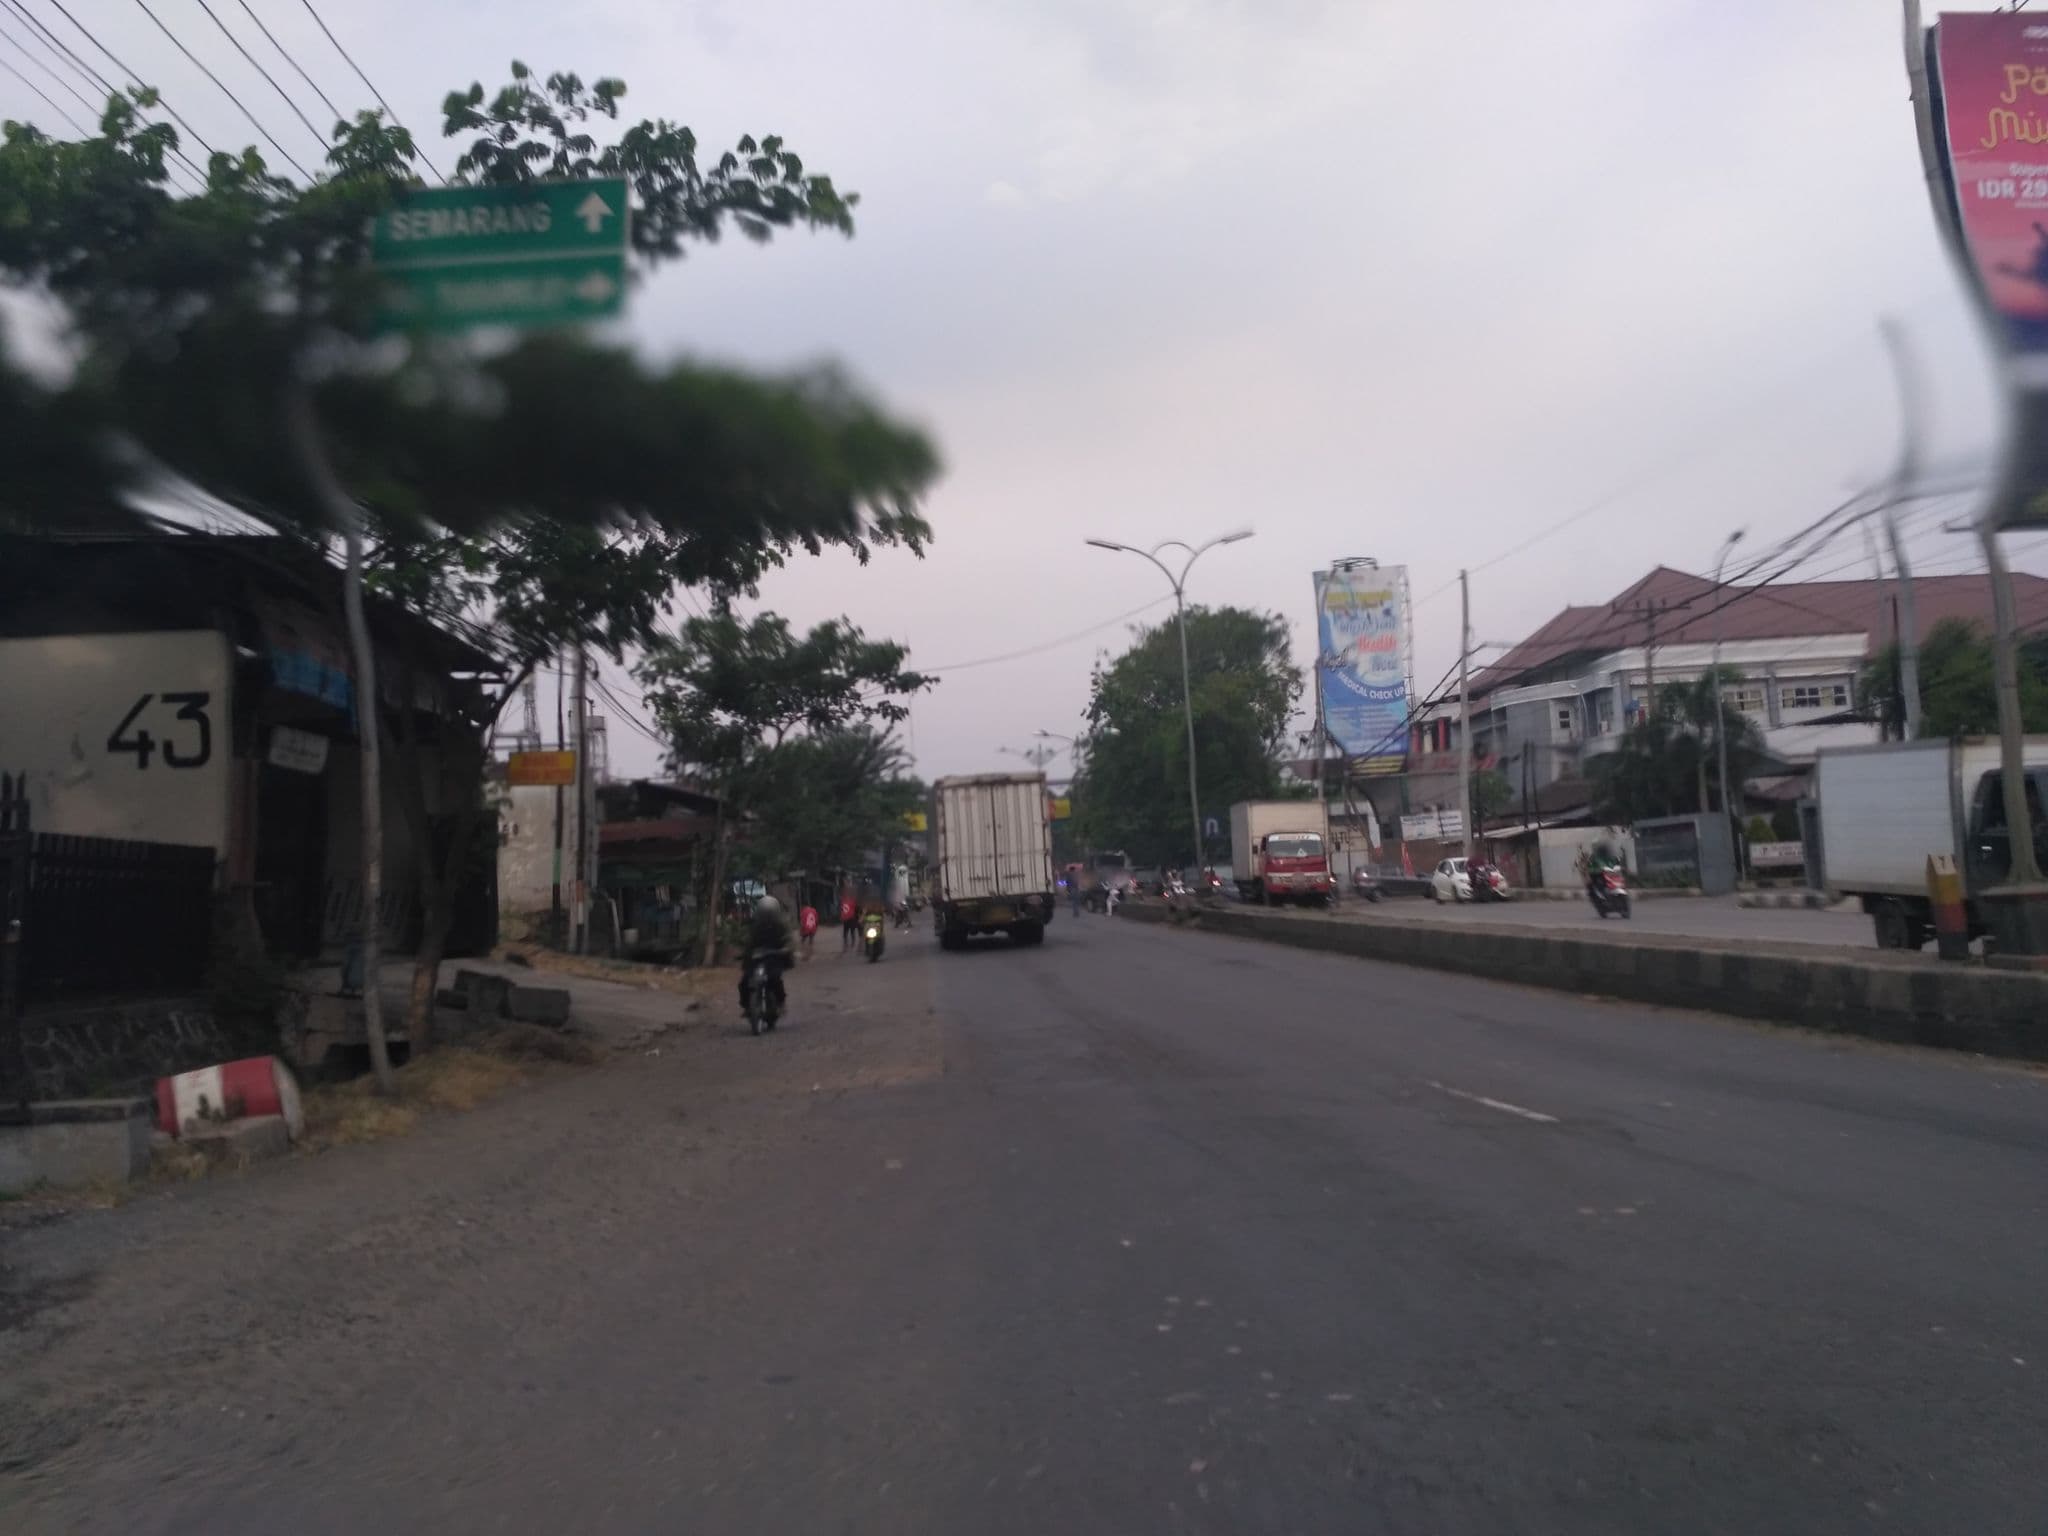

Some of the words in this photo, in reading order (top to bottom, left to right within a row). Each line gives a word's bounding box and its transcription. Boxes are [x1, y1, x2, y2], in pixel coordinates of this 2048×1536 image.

[1977, 178, 2016, 200] IDR
[389, 201, 552, 242] SEMARANG
[1337, 672, 1367, 697] MEDICAL
[1369, 689, 1393, 700] CHECK
[1393, 686, 1404, 697] UP
[107, 691, 211, 771] 43
